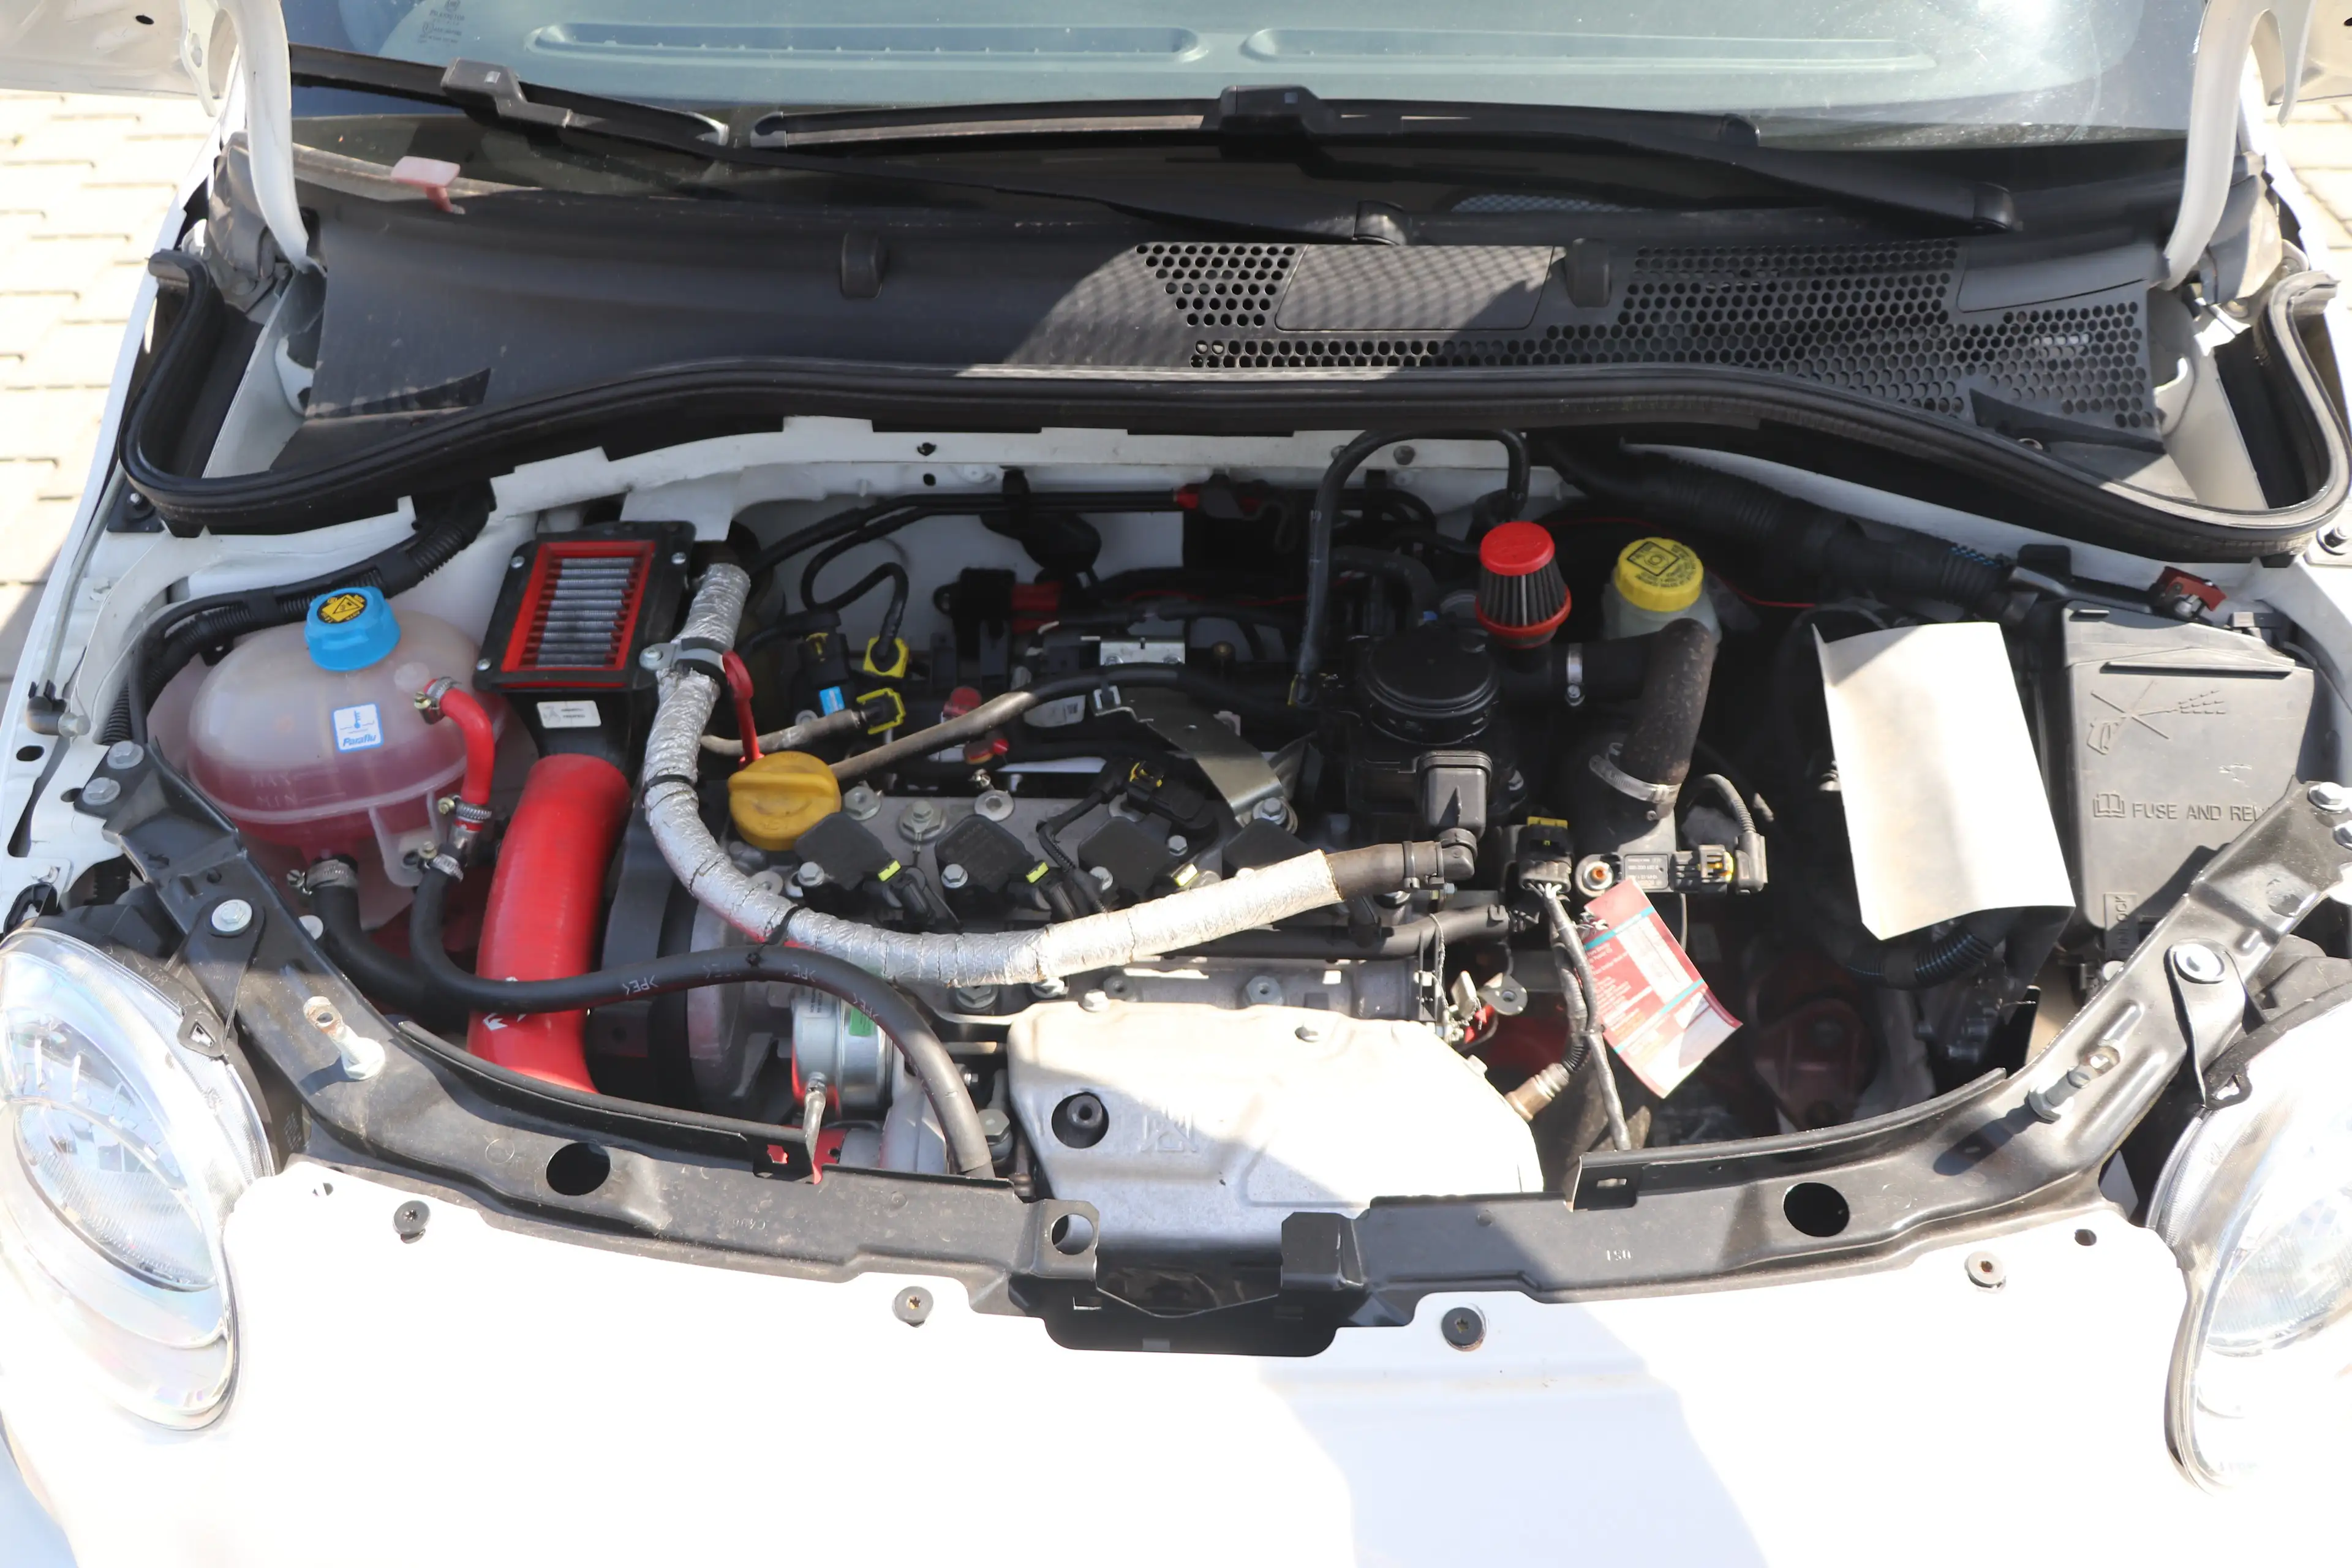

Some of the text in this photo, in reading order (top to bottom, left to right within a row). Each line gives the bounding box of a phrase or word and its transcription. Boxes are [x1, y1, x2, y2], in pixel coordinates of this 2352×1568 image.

[343, 734, 377, 747] Paraflu
[251, 770, 292, 788] MAX
[256, 793, 298, 809] MIN
[2132, 802, 2178, 820] FUSE
[2186, 804, 2222, 821] AND
